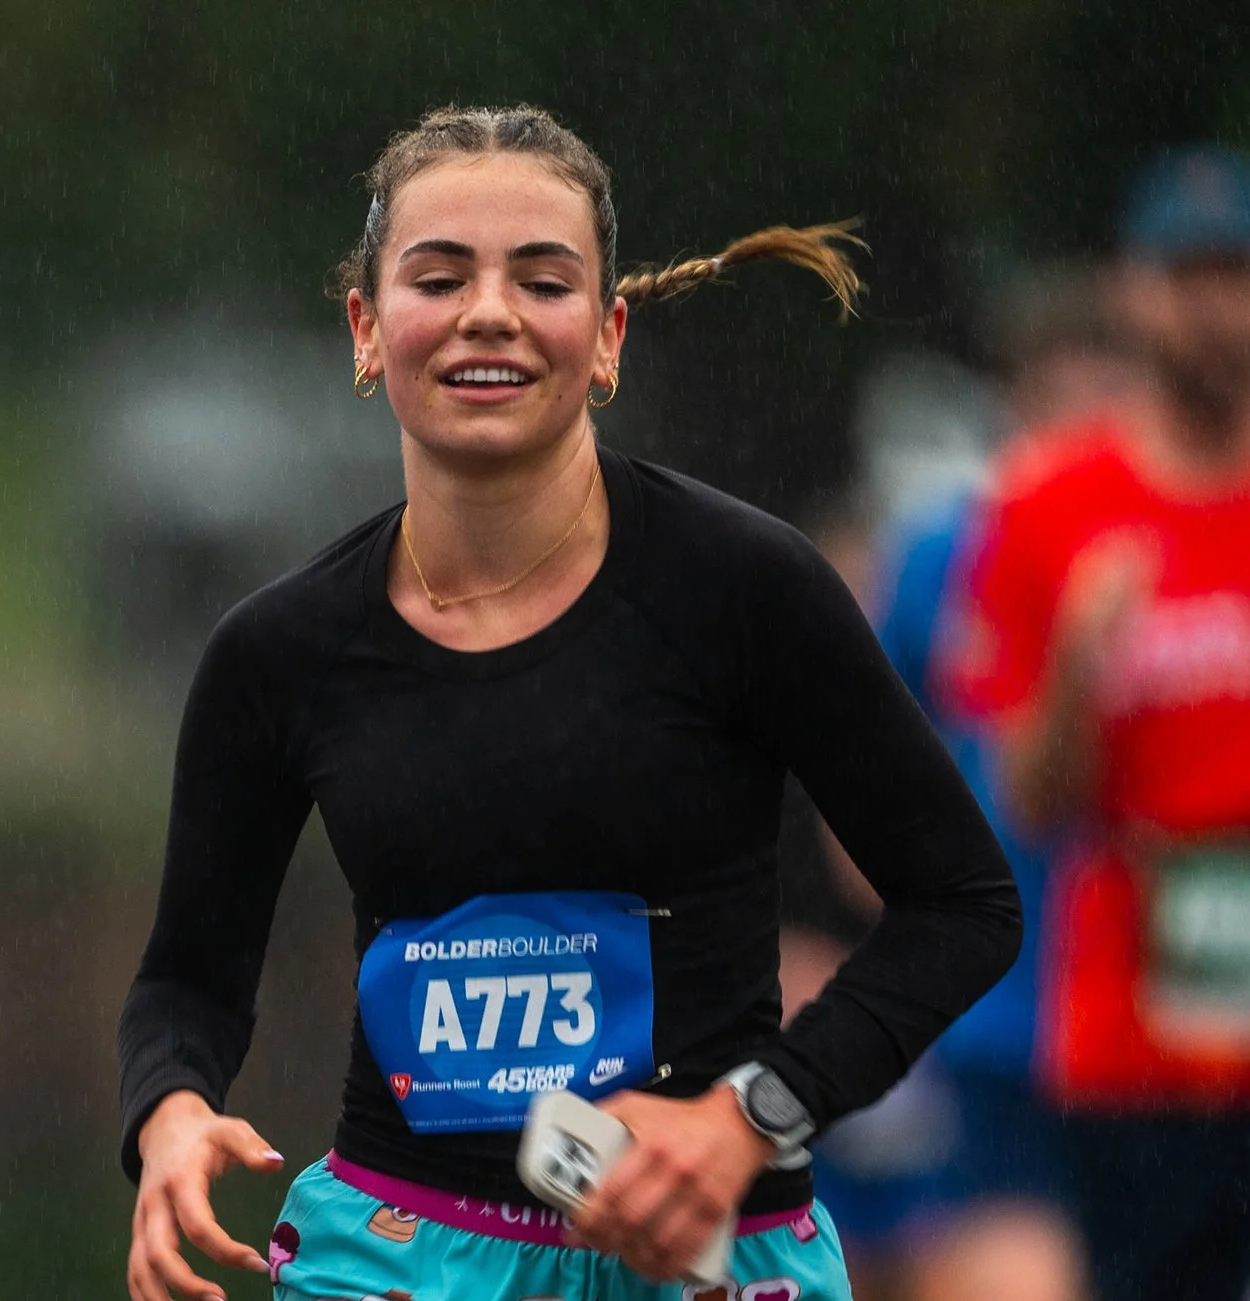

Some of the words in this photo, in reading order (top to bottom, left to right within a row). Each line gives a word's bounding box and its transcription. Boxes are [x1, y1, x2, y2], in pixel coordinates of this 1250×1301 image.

[405, 933, 598, 961] BOLDERBOULDER
[418, 972, 596, 1053] A773
[488, 1067, 527, 1094] 45
[526, 1063, 575, 1081] YEARS
[596, 1057, 624, 1075] RUN
[412, 1080, 451, 1093] Runners
[453, 1078, 480, 1090] Roost
